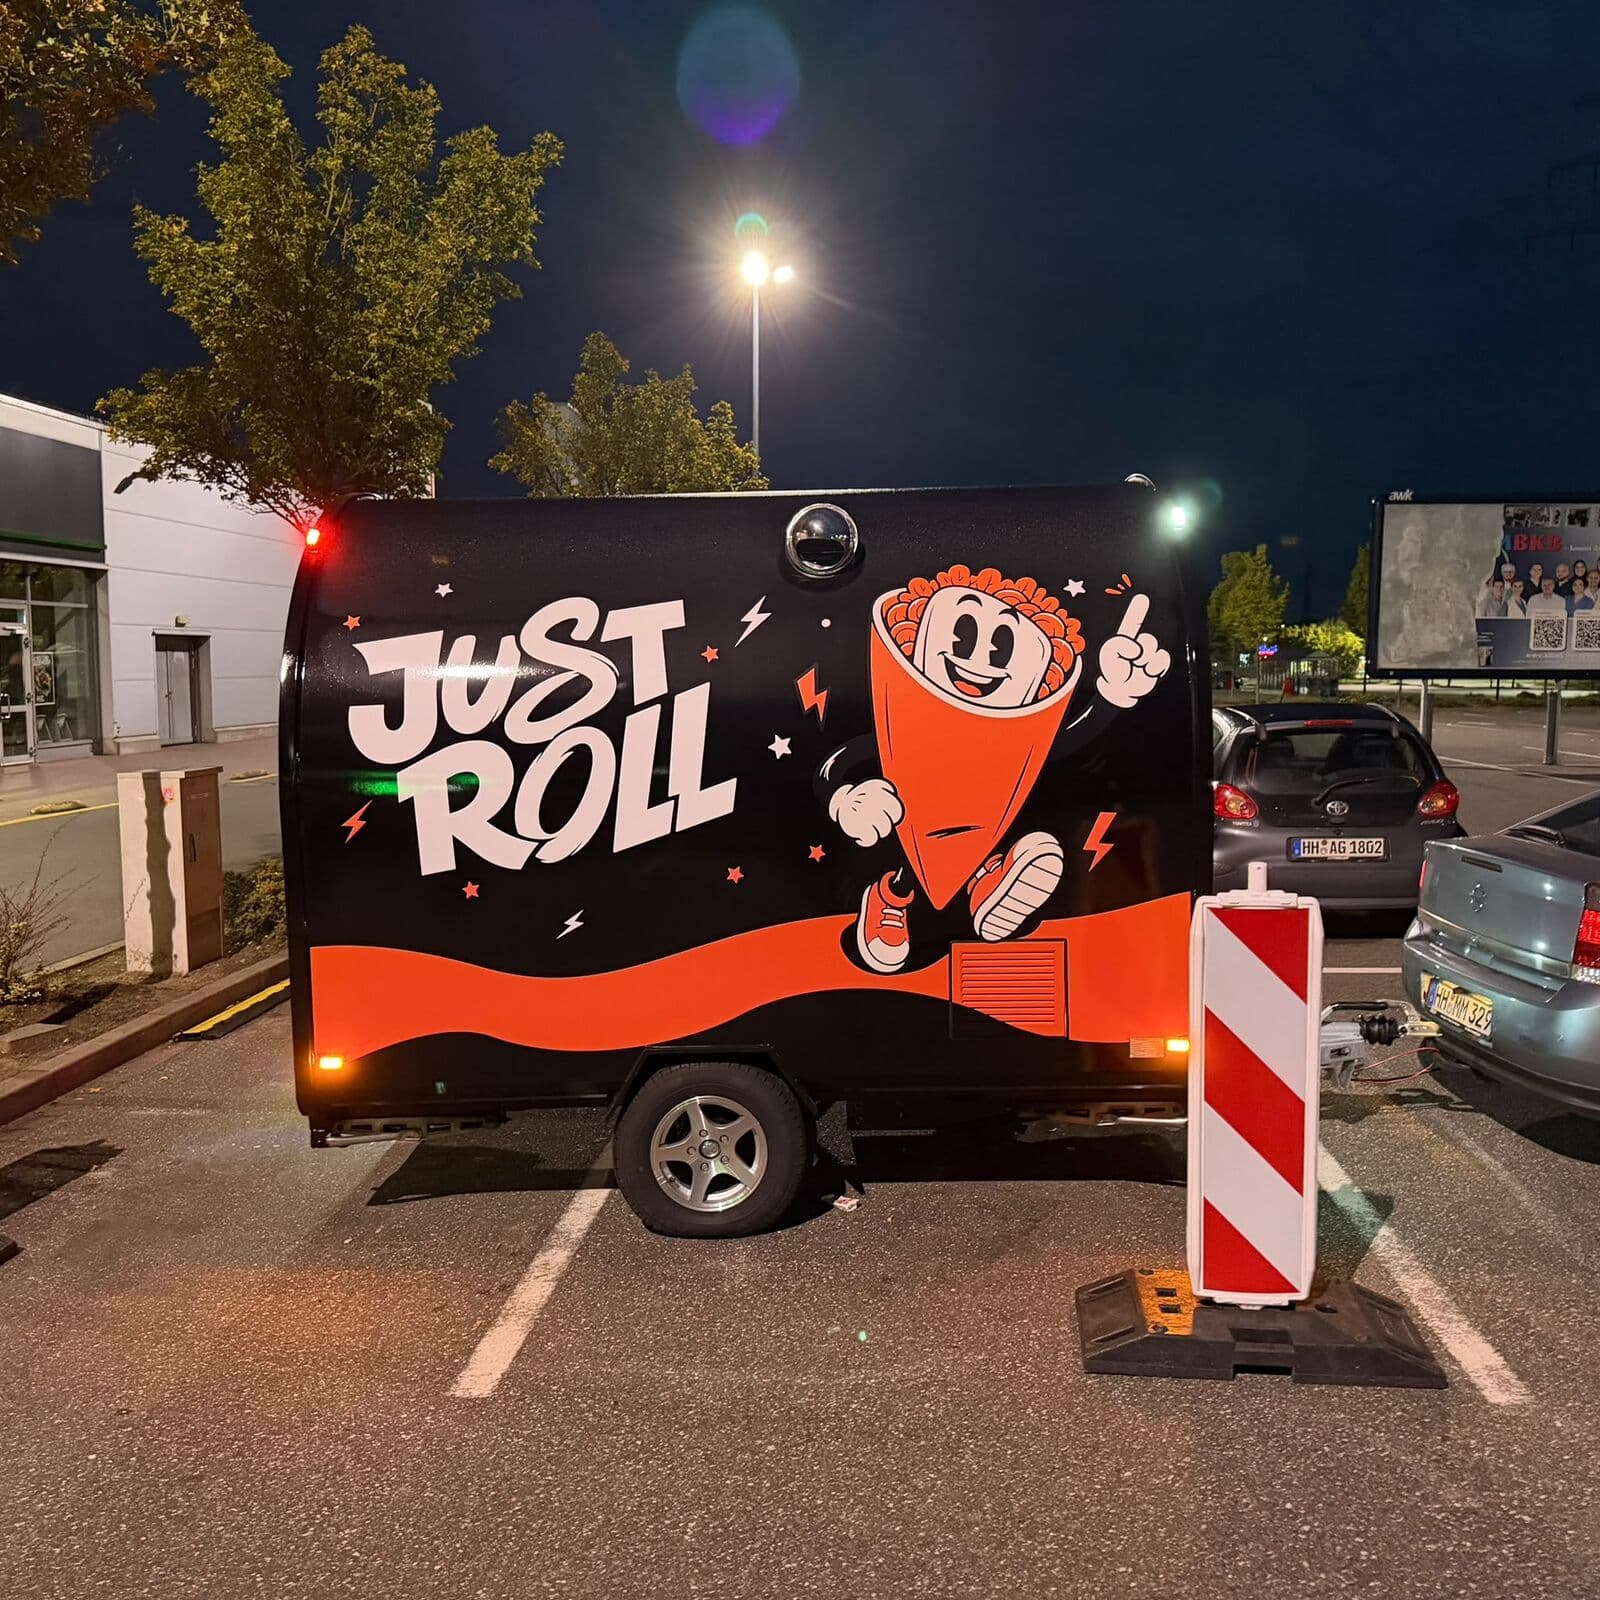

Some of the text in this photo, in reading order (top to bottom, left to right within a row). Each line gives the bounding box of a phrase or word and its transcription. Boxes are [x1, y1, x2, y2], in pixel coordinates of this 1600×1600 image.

[1389, 489, 1413, 501] awk
[348, 597, 685, 765] JUST
[397, 682, 737, 875] ROLL
[1302, 840, 1382, 854] HH AG 1802
